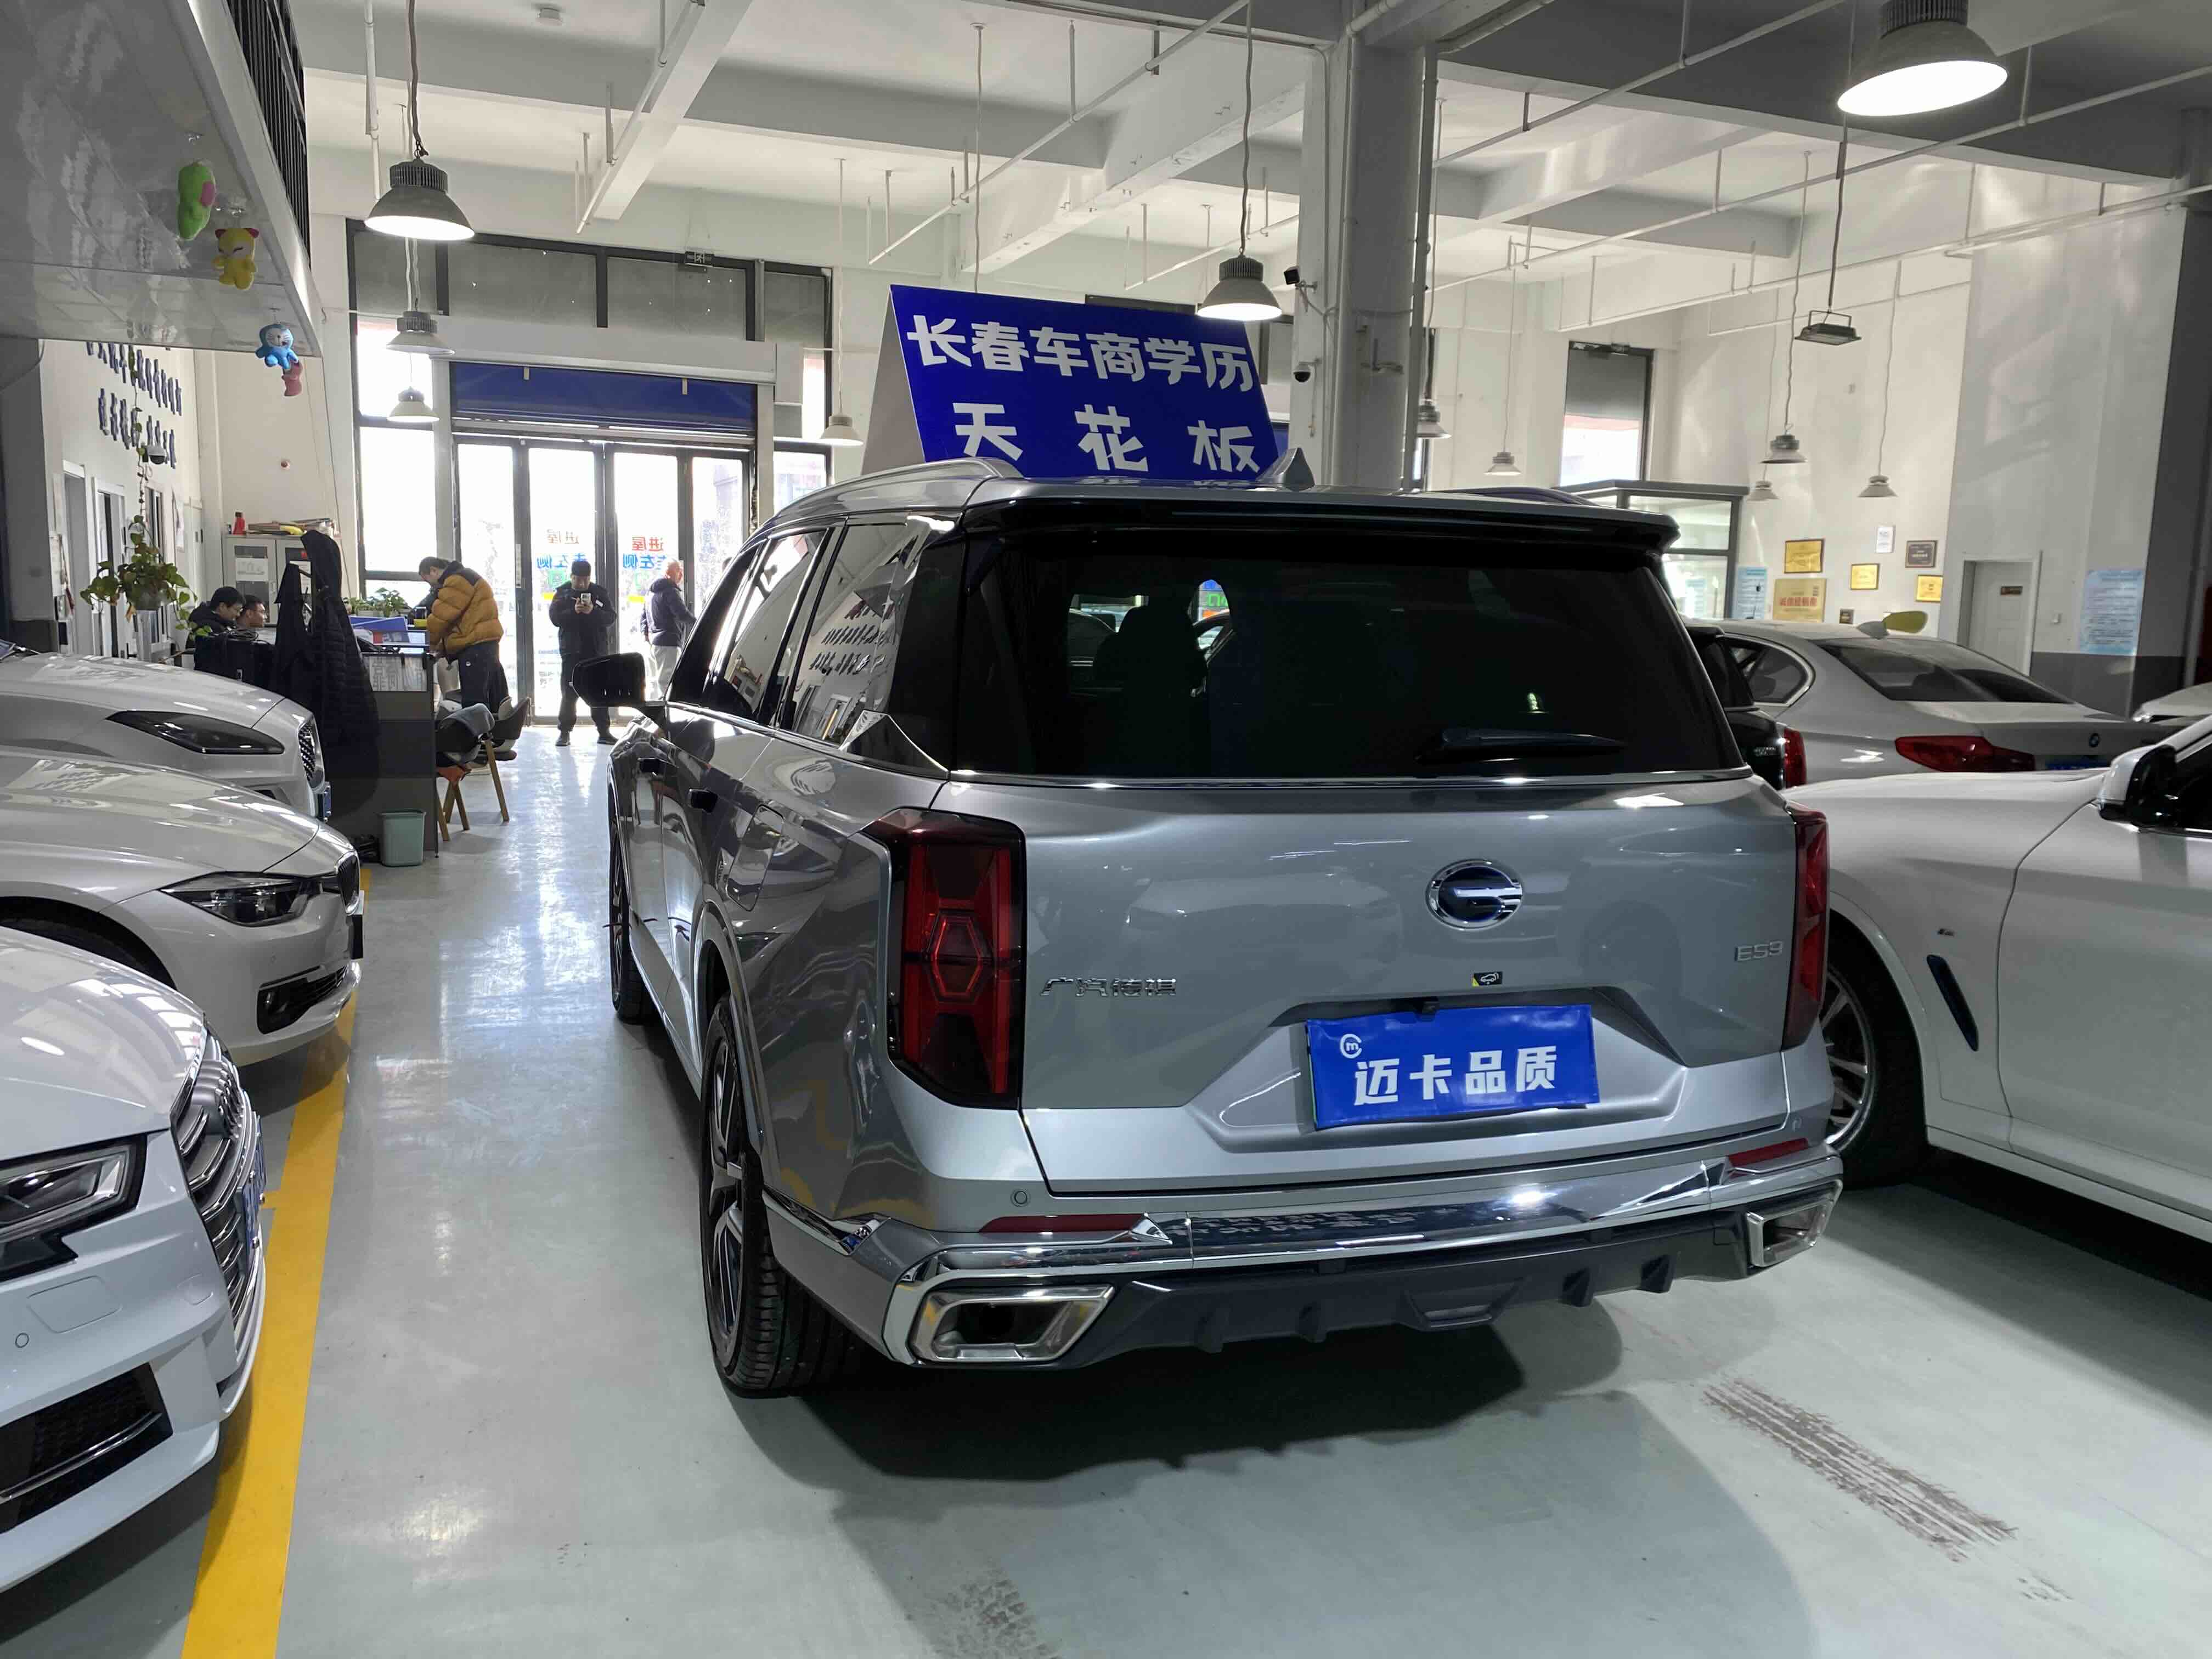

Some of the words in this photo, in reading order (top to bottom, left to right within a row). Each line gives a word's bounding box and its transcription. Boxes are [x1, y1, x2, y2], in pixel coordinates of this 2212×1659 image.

[907, 314, 1255, 392] 长春车商学历
[952, 402, 1260, 473] 天花板
[1734, 940, 1783, 961] ES9
[1354, 1045, 1558, 1105] 迈卡品质
